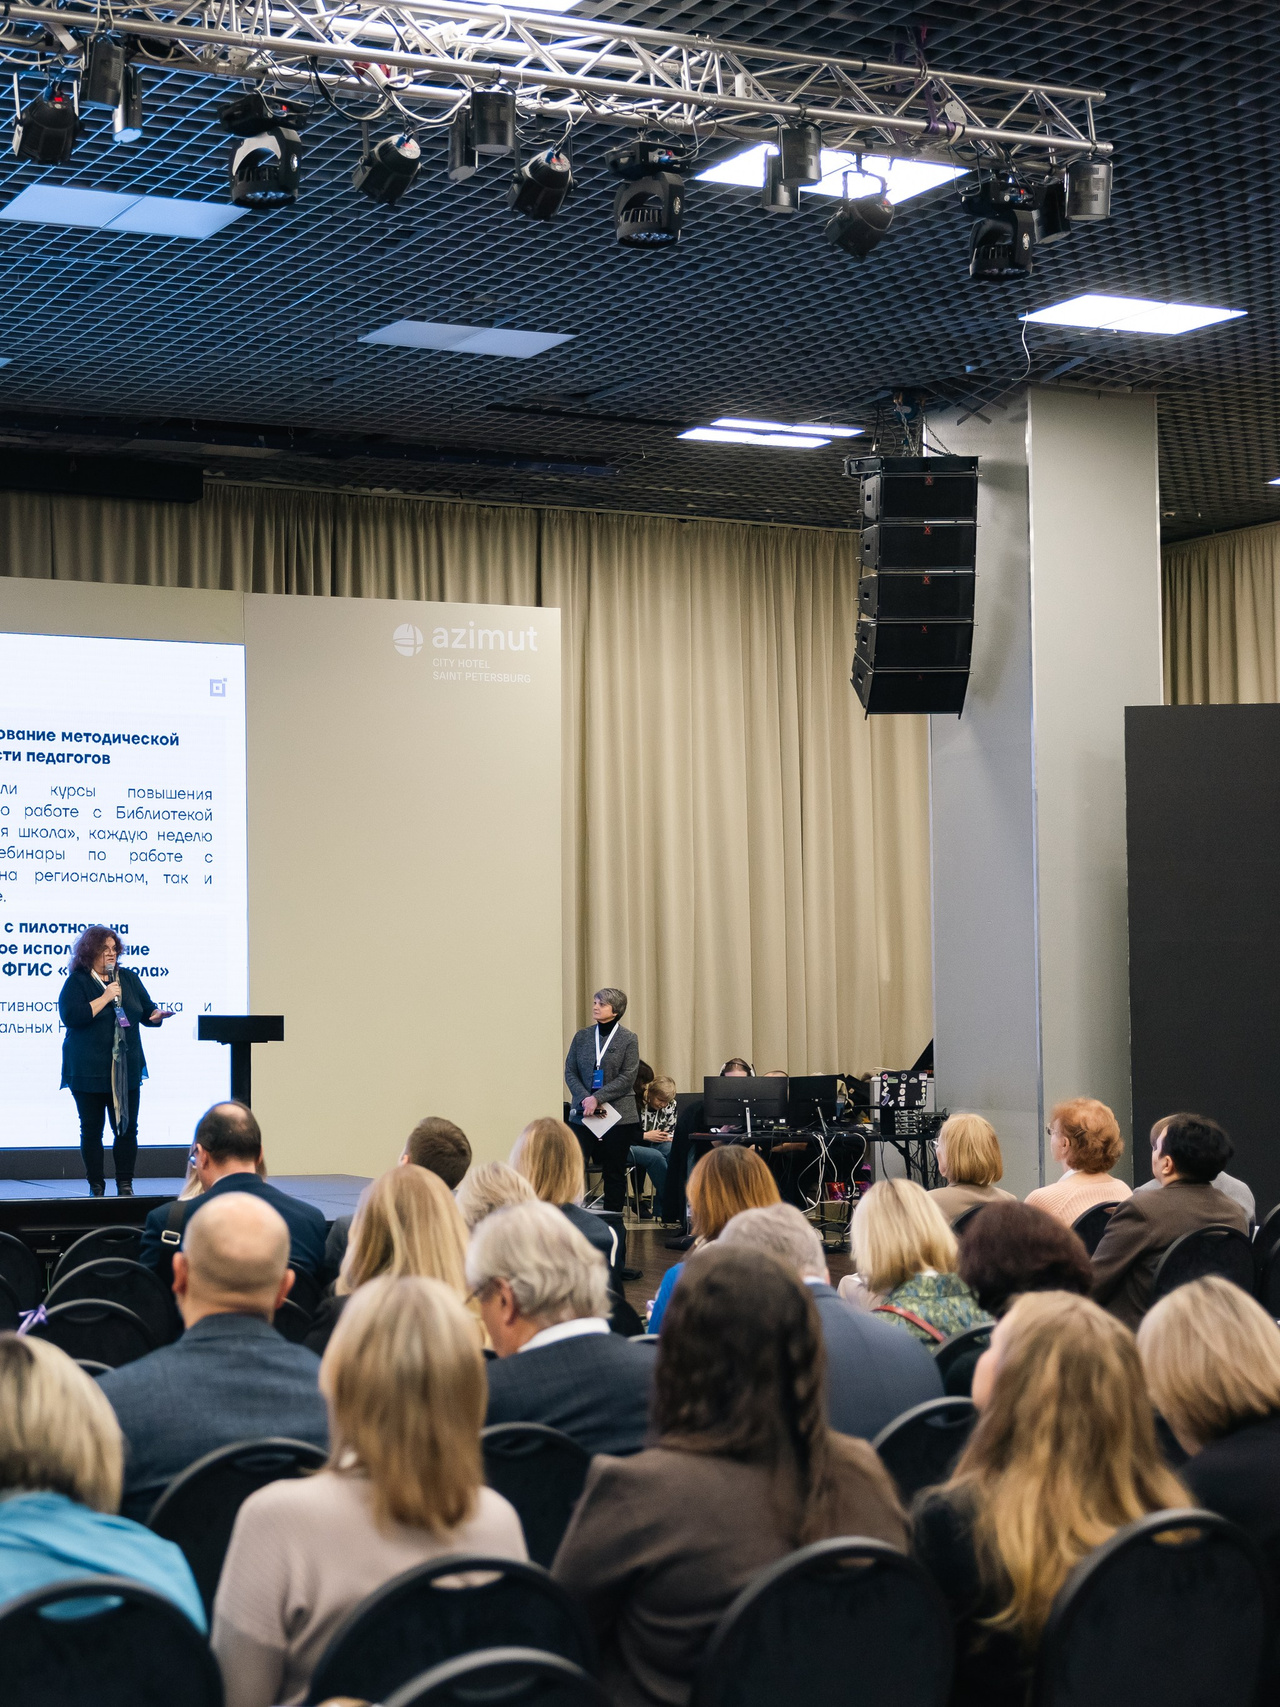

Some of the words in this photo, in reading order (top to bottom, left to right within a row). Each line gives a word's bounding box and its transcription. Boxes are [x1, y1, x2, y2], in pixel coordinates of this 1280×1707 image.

[431, 621, 538, 652] azimut
[432, 658, 455, 668] CITY
[458, 659, 491, 669] HOTEL
[432, 671, 462, 681] SAINT
[465, 672, 531, 684] PETERSBURG
[61, 731, 180, 747] методической
[26, 751, 111, 766] педагогов
[50, 785, 96, 800] курсы
[127, 787, 213, 801] повышения
[24, 803, 80, 820] работе
[92, 808, 102, 819] с
[116, 805, 213, 822] Библиотекой
[18, 827, 80, 842] школа»,
[89, 829, 148, 844] каждую
[157, 830, 213, 844] неделю
[88, 850, 107, 861] по
[129, 848, 183, 865] работе
[204, 853, 213, 864] с
[0, 870, 18, 882] на
[34, 871, 148, 886] региональном,
[162, 873, 189, 885] так
[204, 874, 213, 885] и
[4, 922, 14, 934] с
[19, 922, 104, 935] пилотно
[109, 923, 129, 935] на
[1, 961, 53, 977] ФГИС
[204, 1002, 212, 1013] и
